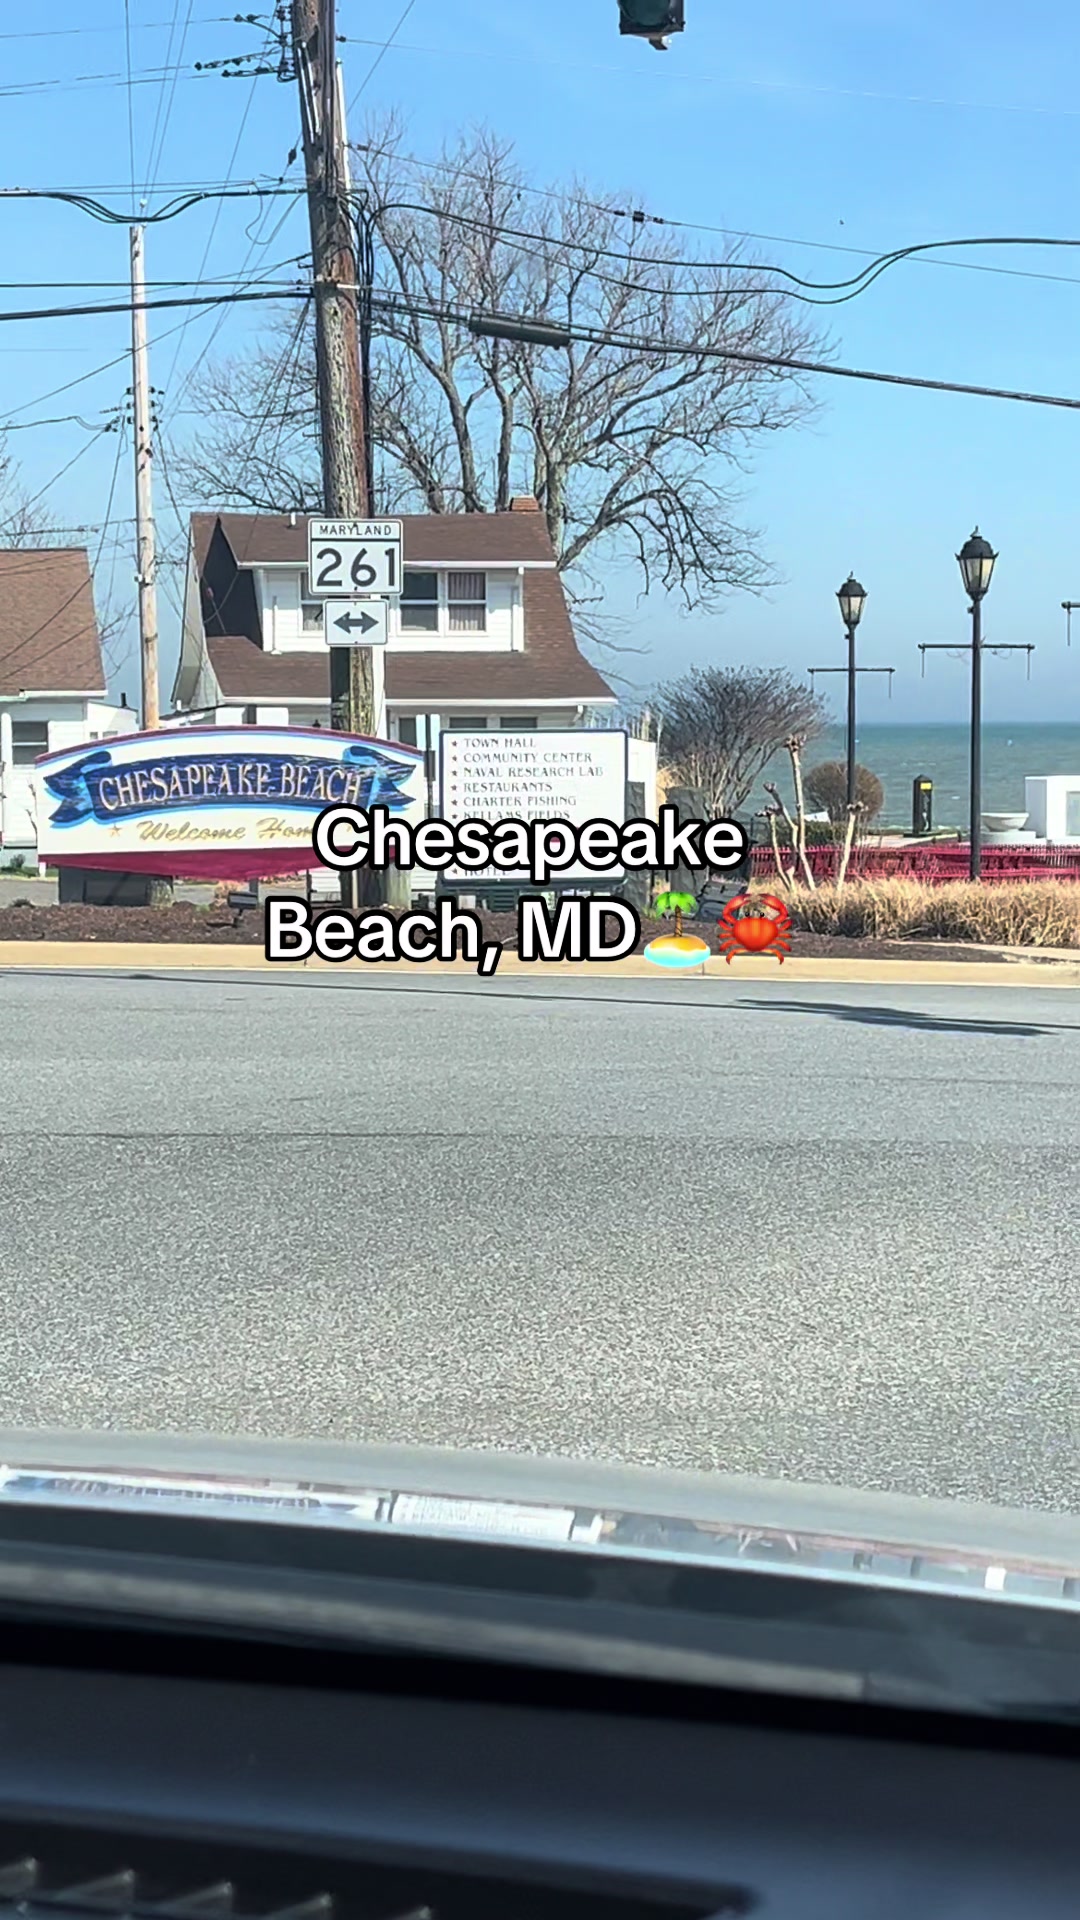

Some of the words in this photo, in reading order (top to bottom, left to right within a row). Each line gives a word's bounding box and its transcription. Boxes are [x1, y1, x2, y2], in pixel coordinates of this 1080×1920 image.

[320, 525, 391, 535] MARYLAND
[316, 547, 395, 587] 261
[464, 738, 499, 748] TOWN
[504, 738, 537, 748] HALL
[463, 753, 537, 763] COMMUNITY
[543, 752, 593, 763] CENTER
[463, 767, 503, 777] NAVAL
[508, 767, 574, 777] RESEARCH
[578, 767, 604, 776] LAB
[100, 762, 270, 810] CHESAPEAKE
[281, 762, 362, 804] BEACH
[463, 782, 553, 792] RESTAURANTS
[463, 797, 522, 807] CHARTER
[527, 796, 577, 806] FISHING
[463, 810, 522, 820] KELLAMS
[527, 810, 571, 820] FIELDS
[136, 820, 246, 841] Welcome
[255, 816, 314, 839] Hom
